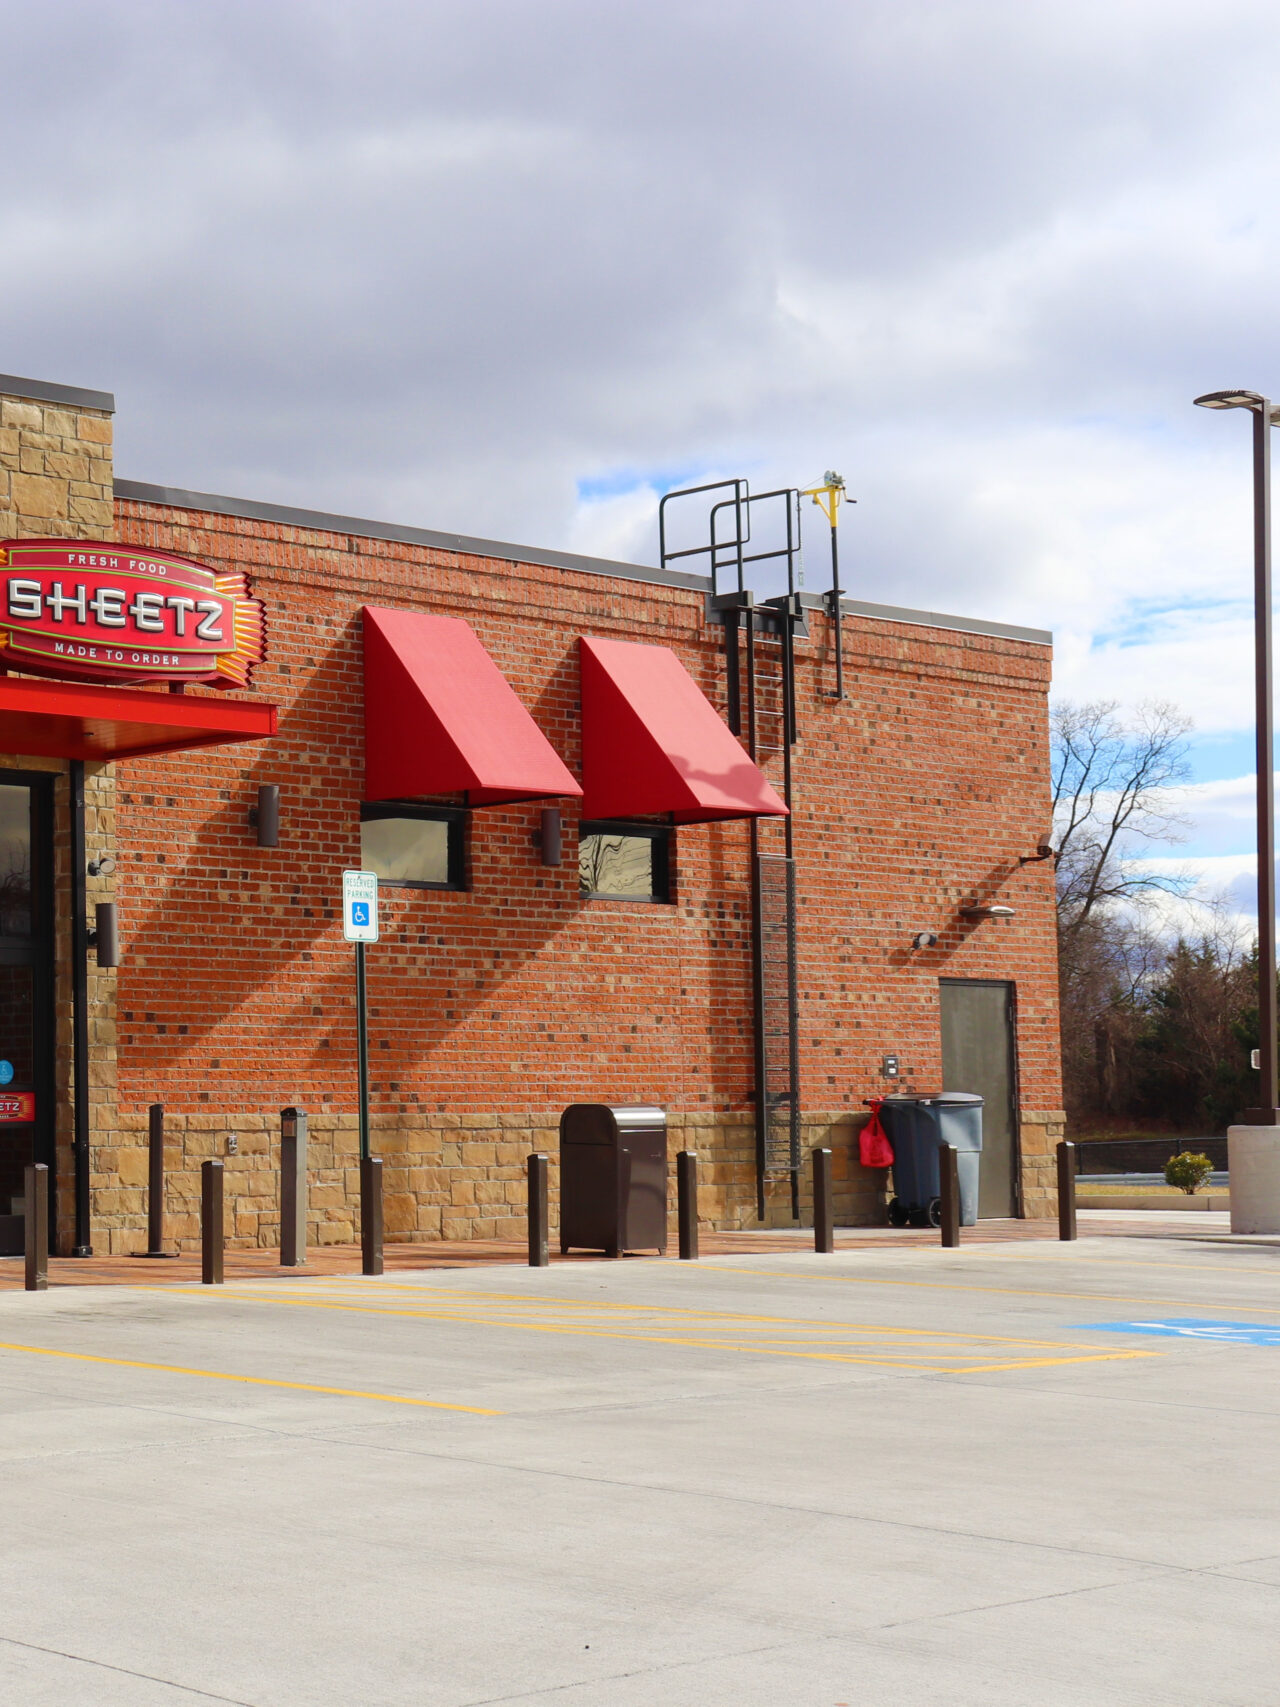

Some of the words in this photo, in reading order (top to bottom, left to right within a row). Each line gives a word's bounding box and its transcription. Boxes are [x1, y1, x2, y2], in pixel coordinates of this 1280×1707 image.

[68, 554, 118, 568] FRESH
[129, 560, 167, 575] FOOD
[8, 578, 222, 641] SHEETZ
[55, 643, 97, 658] MADE
[106, 649, 123, 661] TO
[132, 653, 179, 666] ORDER
